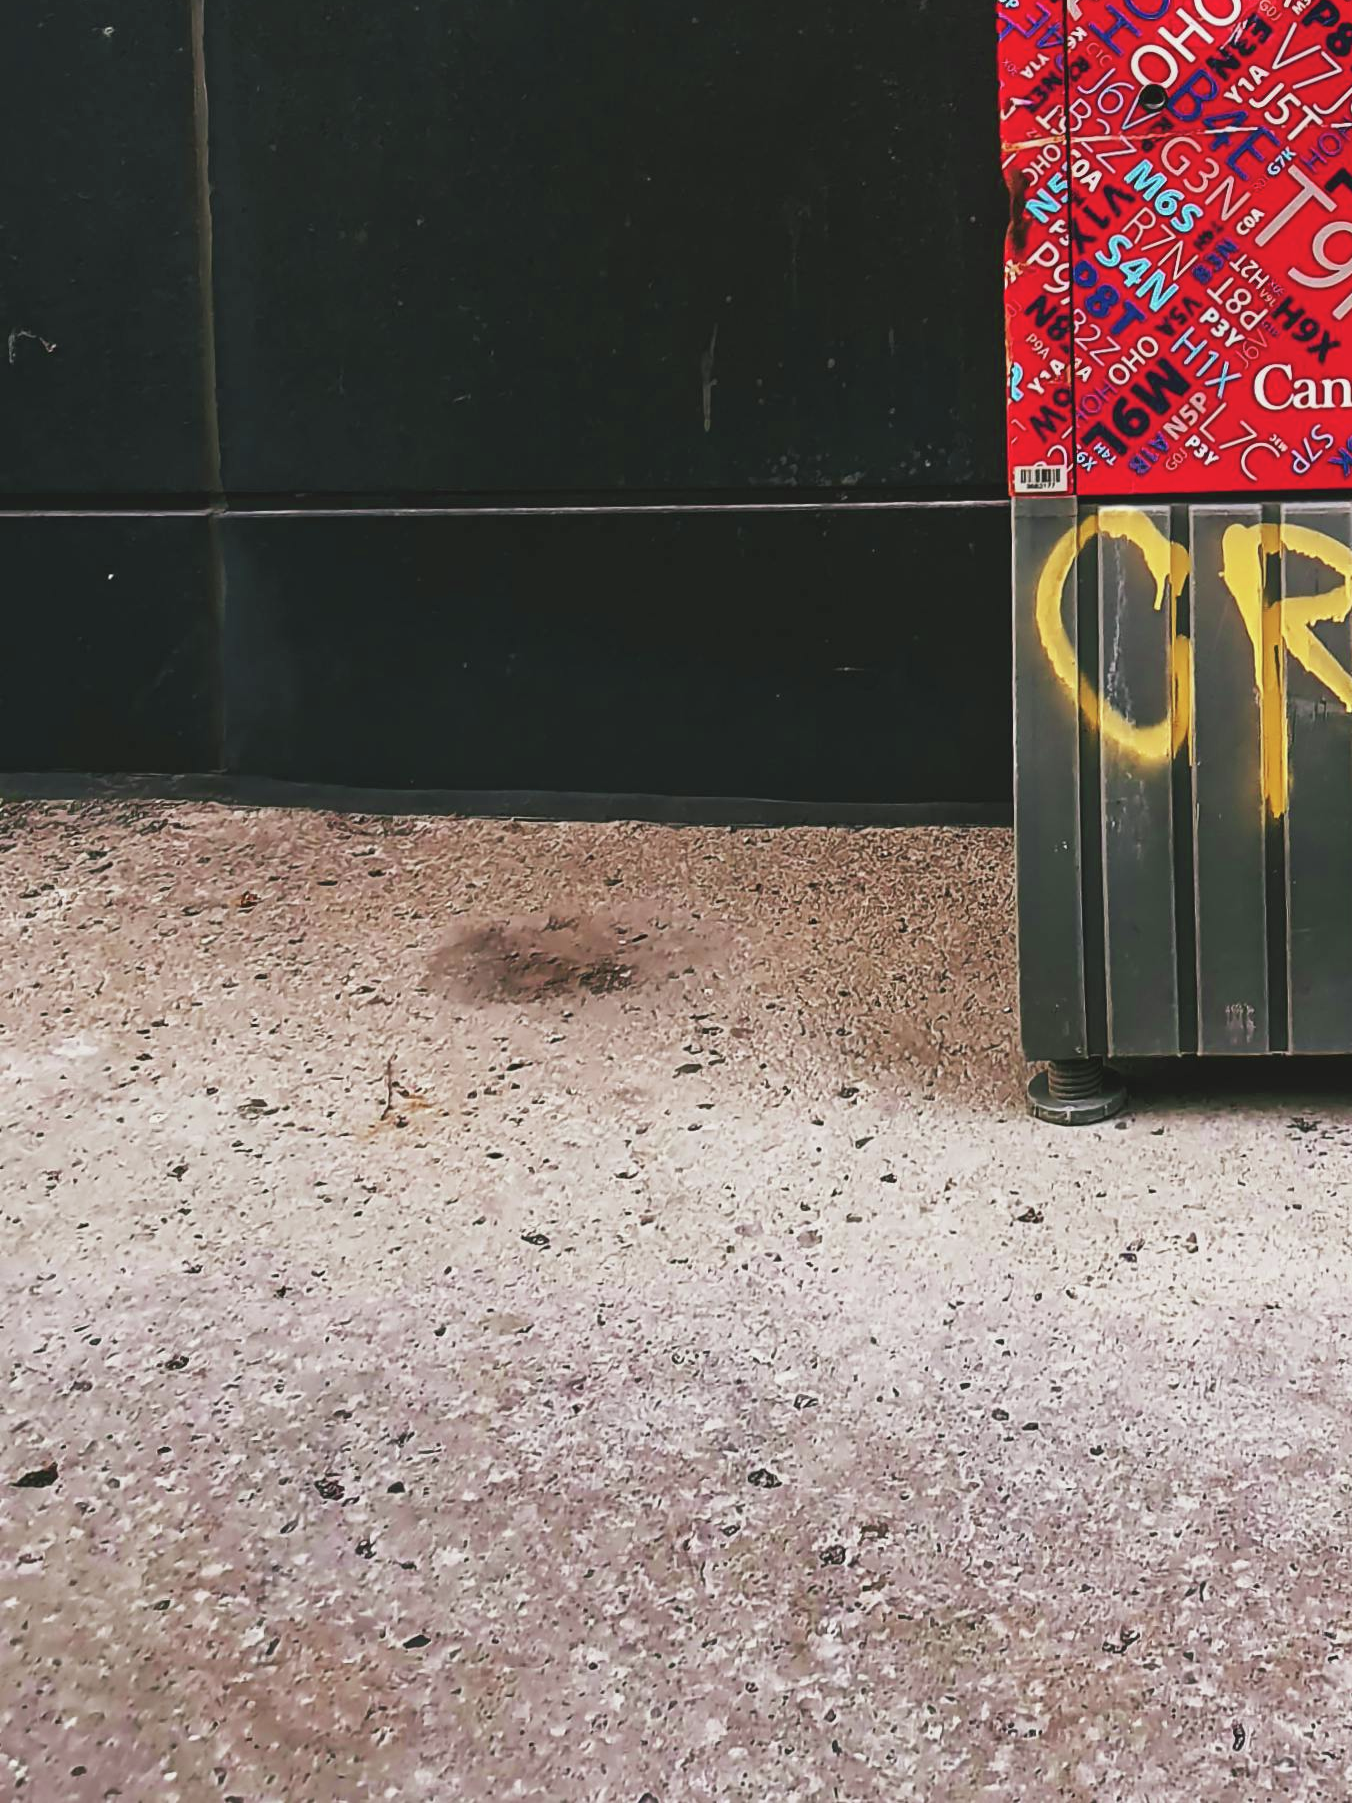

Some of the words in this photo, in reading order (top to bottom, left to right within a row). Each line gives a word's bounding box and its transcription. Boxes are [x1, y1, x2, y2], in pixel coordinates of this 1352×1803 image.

[1020, 53, 1050, 79] Y1A
[1223, 65, 1270, 104] Y1A
[1167, 69, 1281, 181] B4E
[1249, 82, 1323, 141] J5T
[1161, 136, 1251, 221] G3N
[1267, 146, 1296, 176] G7K
[1124, 159, 1204, 233] M6S
[1121, 206, 1201, 281] R7N
[1094, 233, 1180, 313] S4N
[1229, 254, 1270, 290] H2T
[1200, 306, 1245, 347] P3Y
[1206, 276, 1269, 331] P8T
[1271, 297, 1341, 364] H9X
[1026, 333, 1051, 359] P9A
[1170, 326, 1243, 399] H1X
[1081, 358, 1191, 456] M9L
[1163, 392, 1207, 440] N5P
[1093, 442, 1117, 466] T4H
[1184, 434, 1219, 466] P3Y
[1199, 402, 1281, 482] L7C
[1291, 423, 1334, 475] S7P
